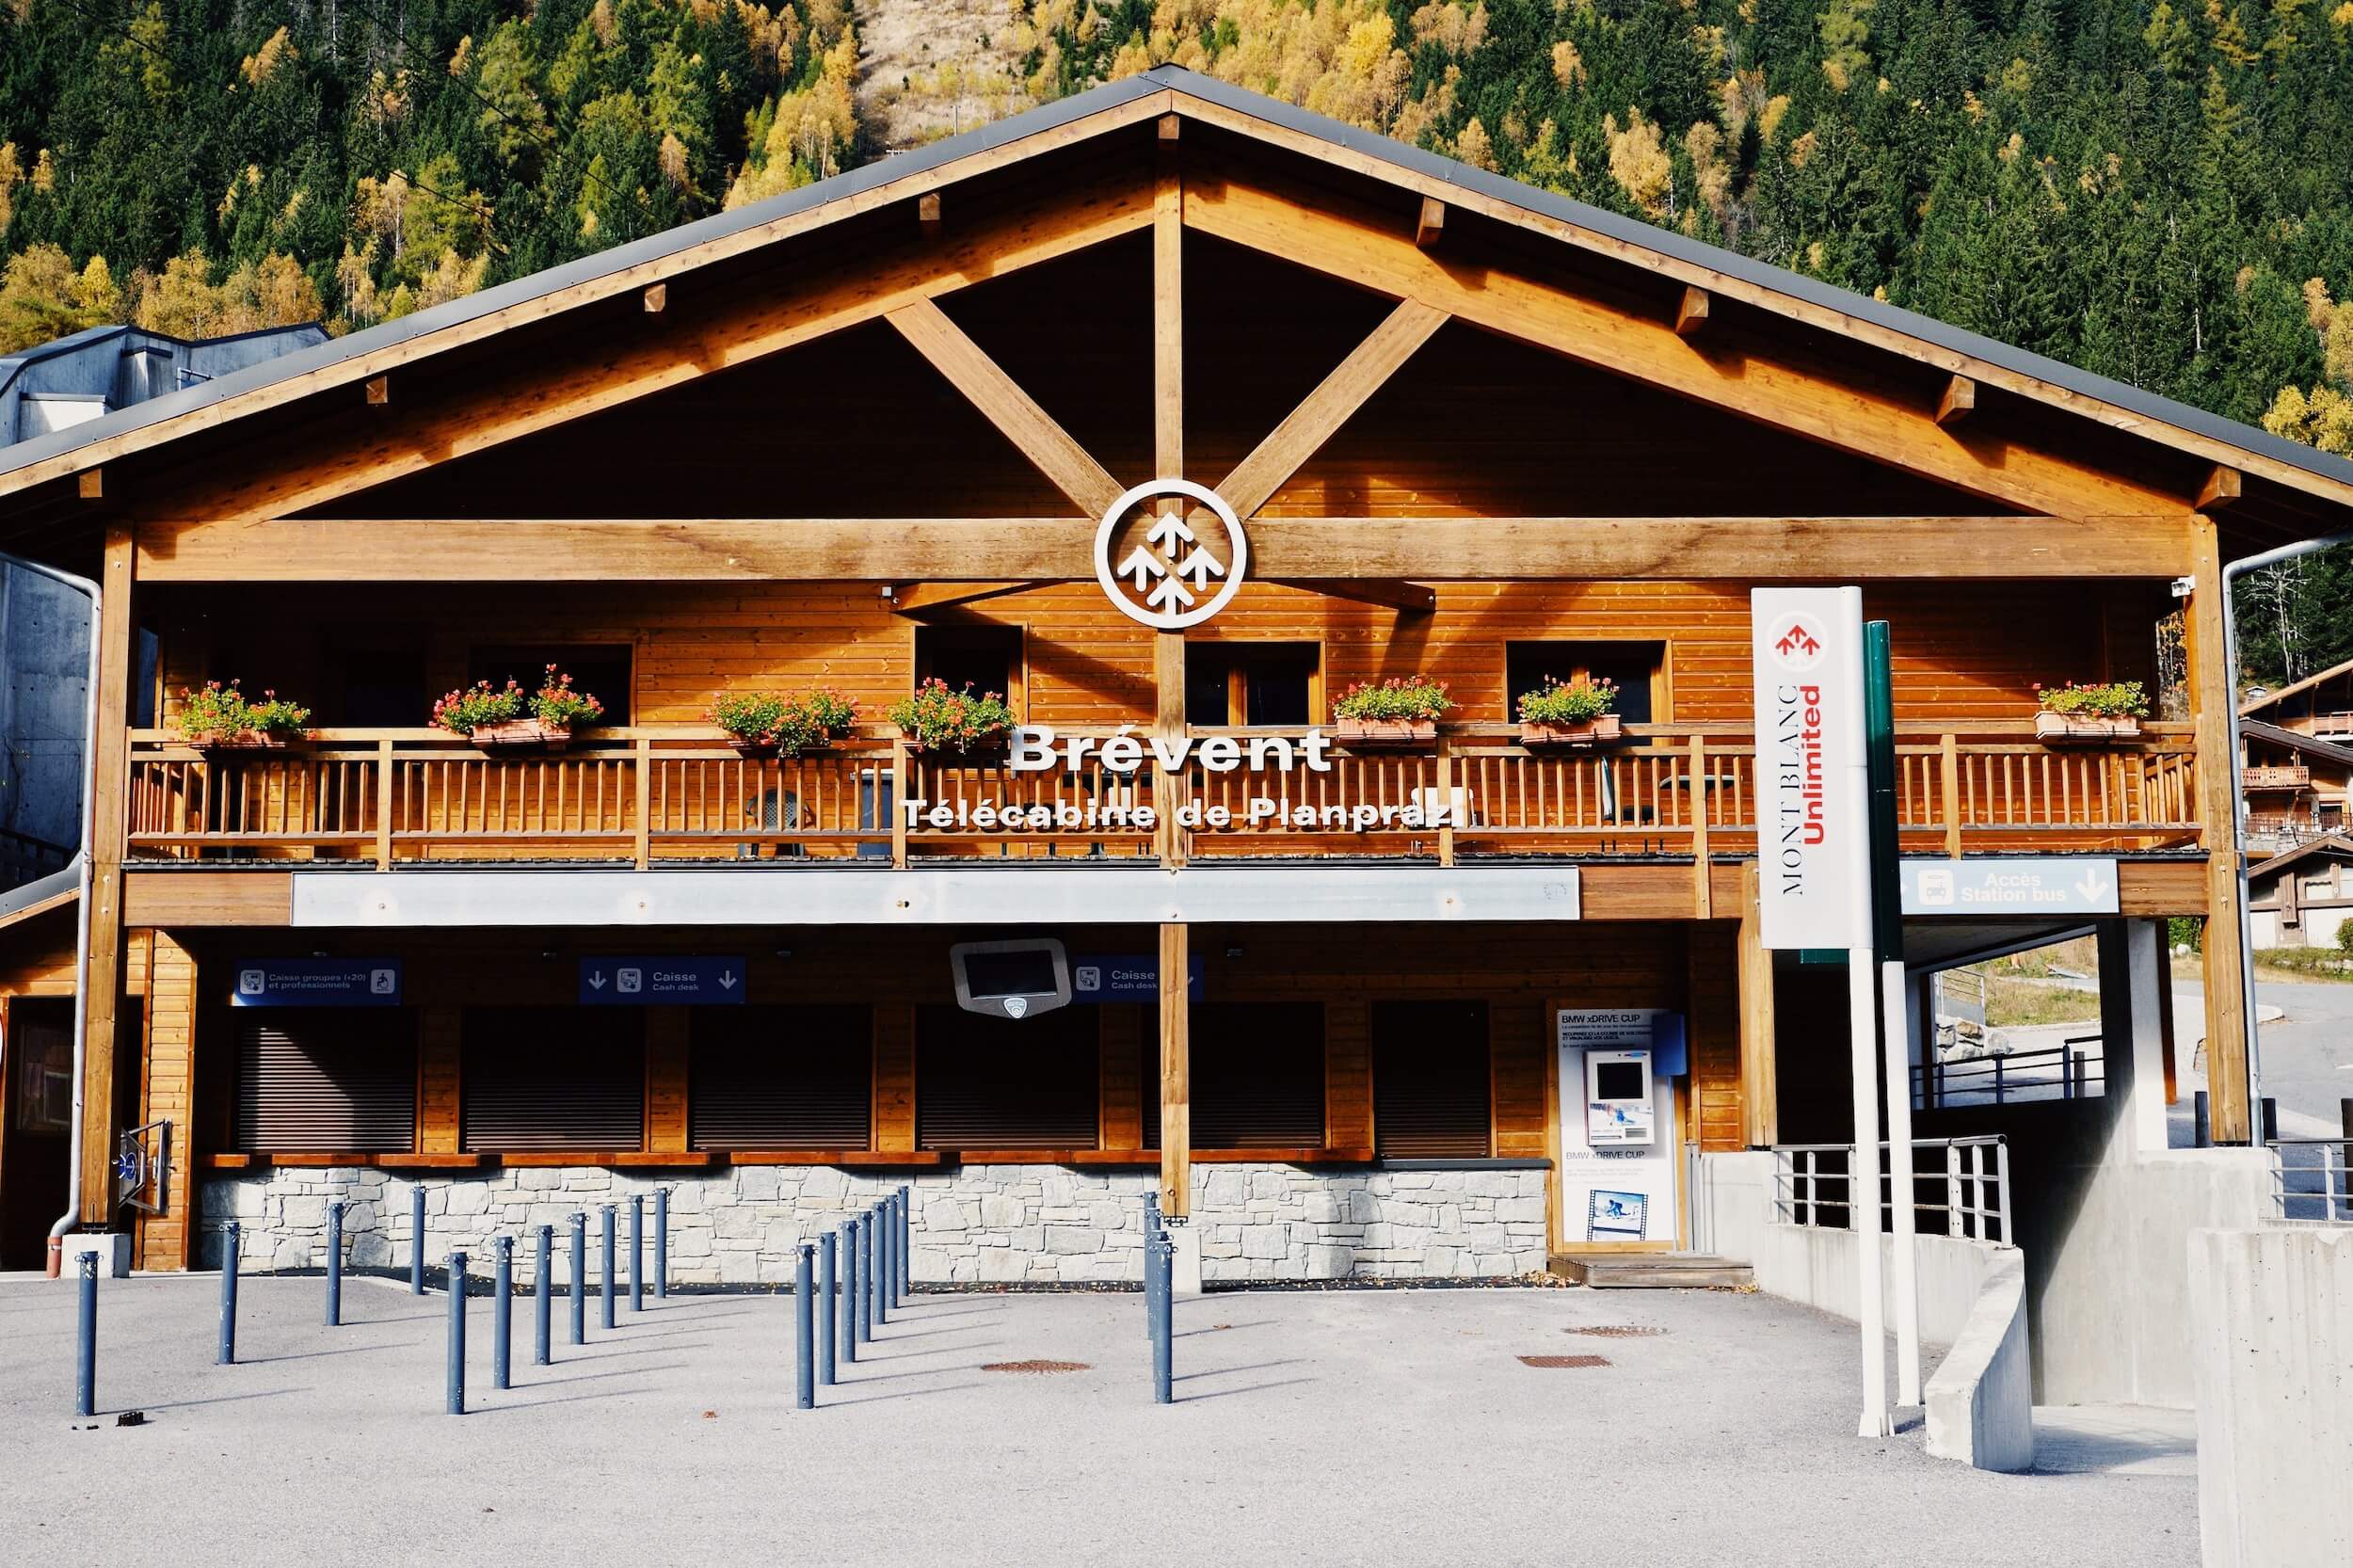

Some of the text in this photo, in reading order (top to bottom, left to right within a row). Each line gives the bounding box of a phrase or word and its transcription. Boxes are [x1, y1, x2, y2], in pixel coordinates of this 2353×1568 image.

[1011, 724, 1332, 772] Brévent
[1800, 684, 1825, 845] Unlimited
[1778, 684, 1802, 896] MONT BLANC
[900, 798, 1452, 833] Télécabine de Planpraz
[1985, 872, 2041, 888] Accès
[1961, 887, 2067, 903] Station bus
[268, 973, 300, 982] Caisse
[302, 974, 342, 984] groupes
[652, 971, 697, 982] Caisse
[1111, 969, 1156, 980] Caisse
[280, 981, 351, 990] professionnels
[1111, 982, 1158, 990] Cash desk
[1561, 1014, 1641, 1024] BMW xDRIVE CUP
[1565, 1150, 1645, 1160] BMW xDRIVE CUP
